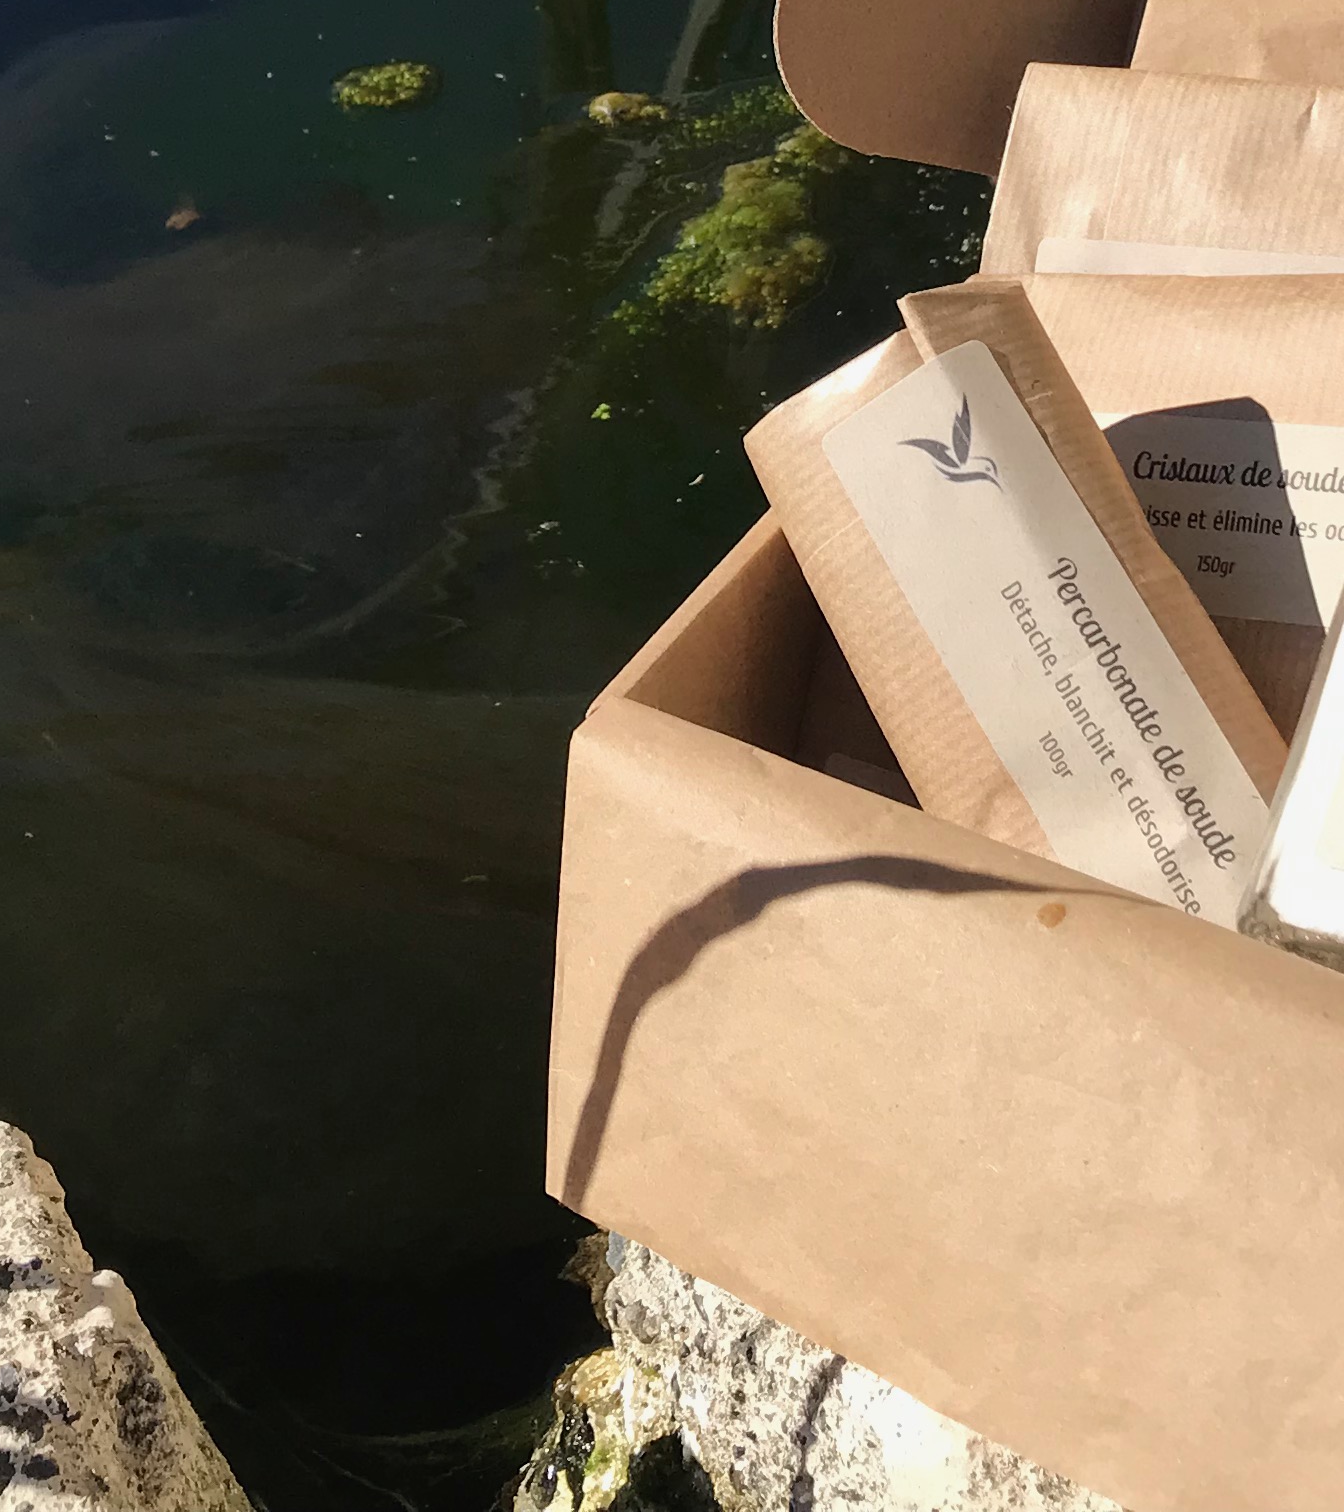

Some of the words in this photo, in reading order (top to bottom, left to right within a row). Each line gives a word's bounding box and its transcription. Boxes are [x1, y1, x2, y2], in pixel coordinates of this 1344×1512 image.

[1133, 451, 1235, 484] Cristaux
[1241, 460, 1272, 488] de
[1143, 504, 1181, 529] isse
[1187, 509, 1207, 530] et
[1213, 507, 1283, 536] élimine
[1290, 515, 1318, 538] les
[1197, 554, 1236, 578] 150gr
[1047, 556, 1163, 745] Percarbonate
[1152, 744, 1186, 784] de
[1175, 785, 1237, 870] soude
[1000, 580, 1058, 677] Détache,
[1054, 673, 1116, 766] blanchit
[1110, 768, 1135, 795] et
[1127, 795, 1202, 915] désodorise
[1038, 730, 1074, 780] 100gr
